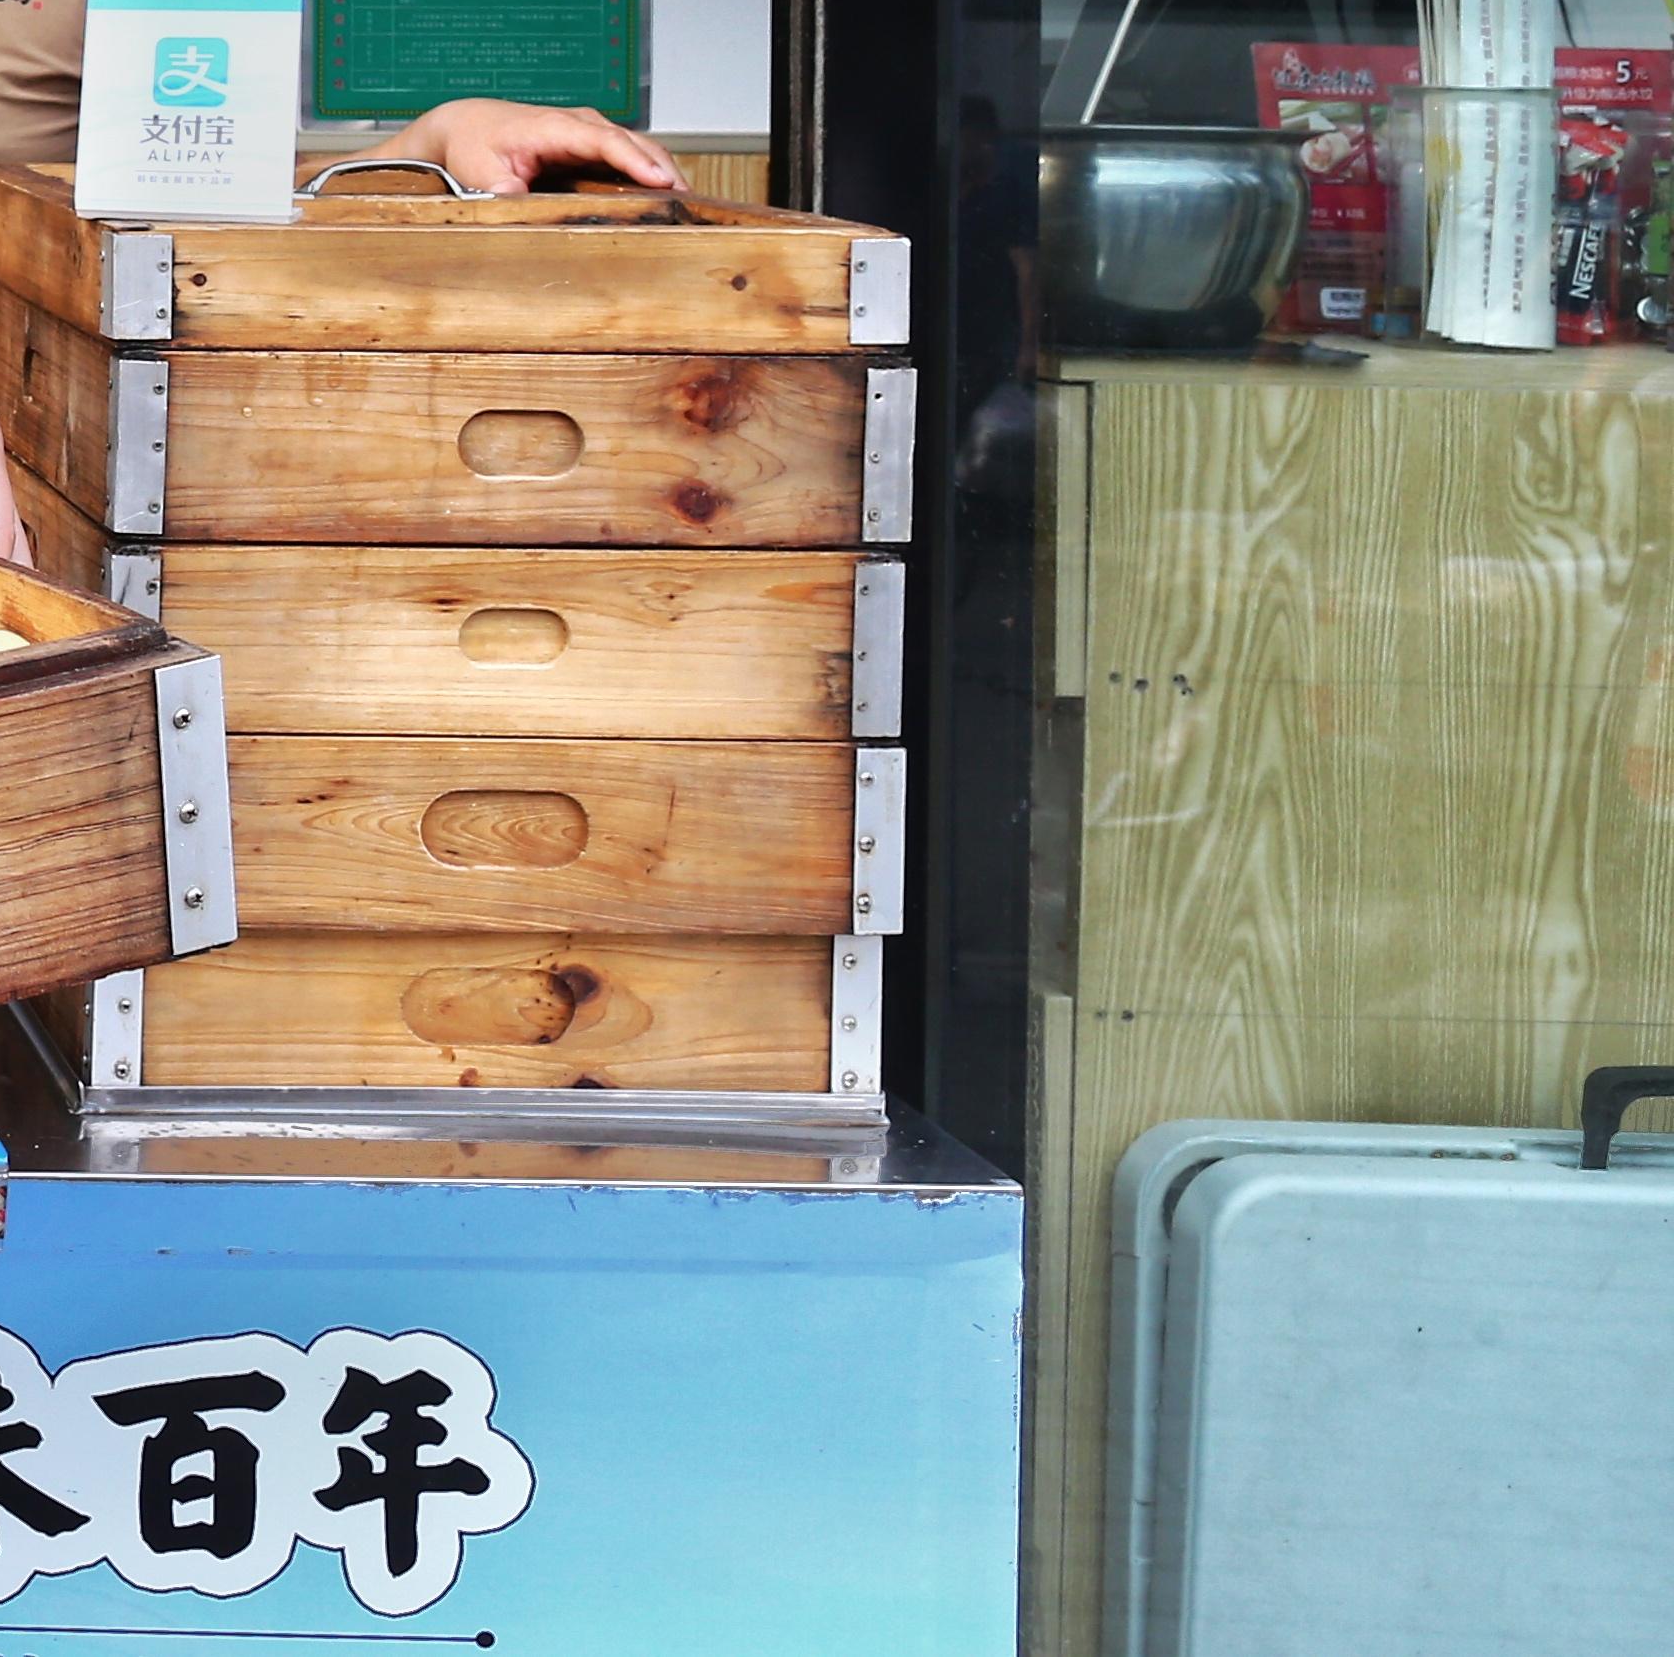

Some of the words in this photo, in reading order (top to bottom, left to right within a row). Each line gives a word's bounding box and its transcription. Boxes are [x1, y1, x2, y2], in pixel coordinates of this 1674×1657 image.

[139, 114, 235, 145] 支付宝
[147, 148, 226, 163] ALIPAY
